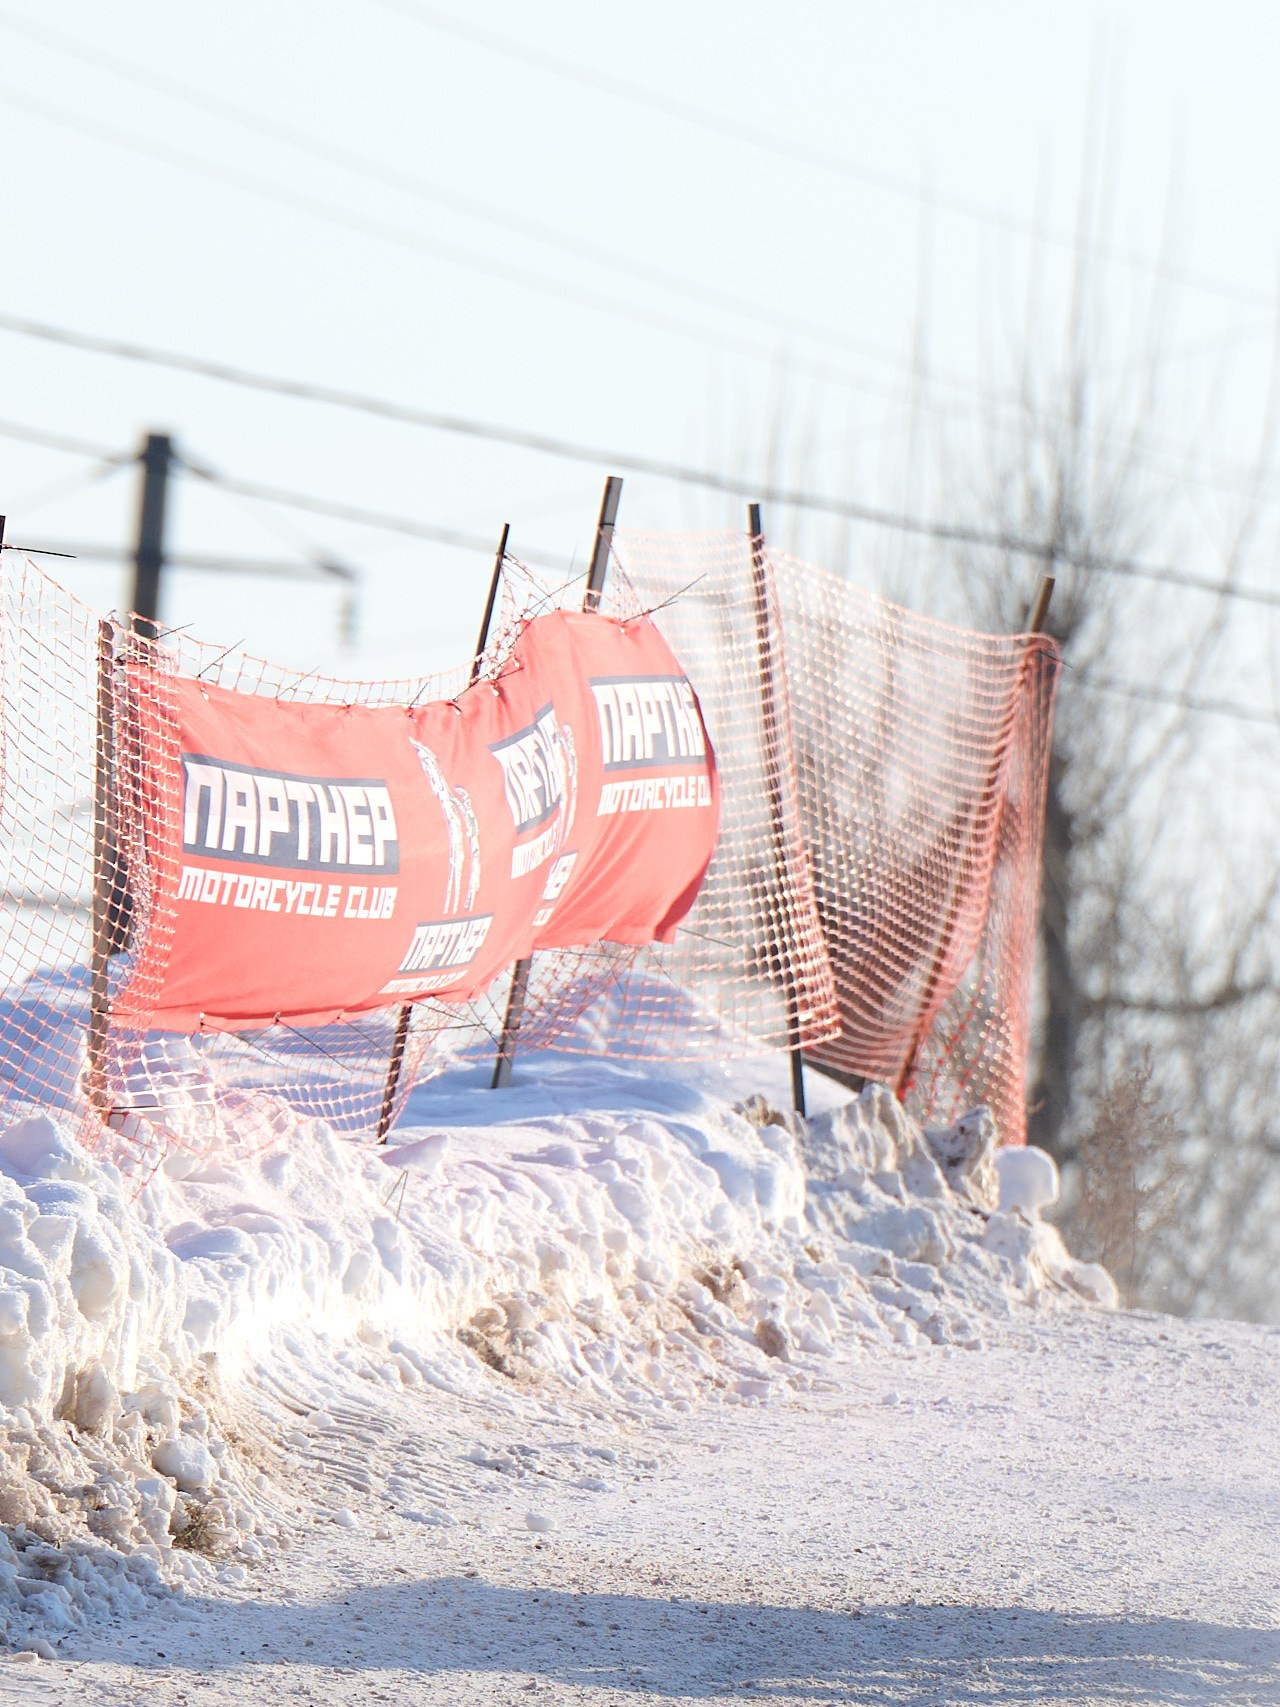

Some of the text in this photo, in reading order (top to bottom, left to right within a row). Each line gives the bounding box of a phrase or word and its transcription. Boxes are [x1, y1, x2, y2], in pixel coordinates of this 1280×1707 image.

[183, 761, 398, 866] ПАРТНЕР
[597, 776, 697, 817] MOTORCYCLE
[178, 865, 398, 919] MOTORCYCLE CLUB
